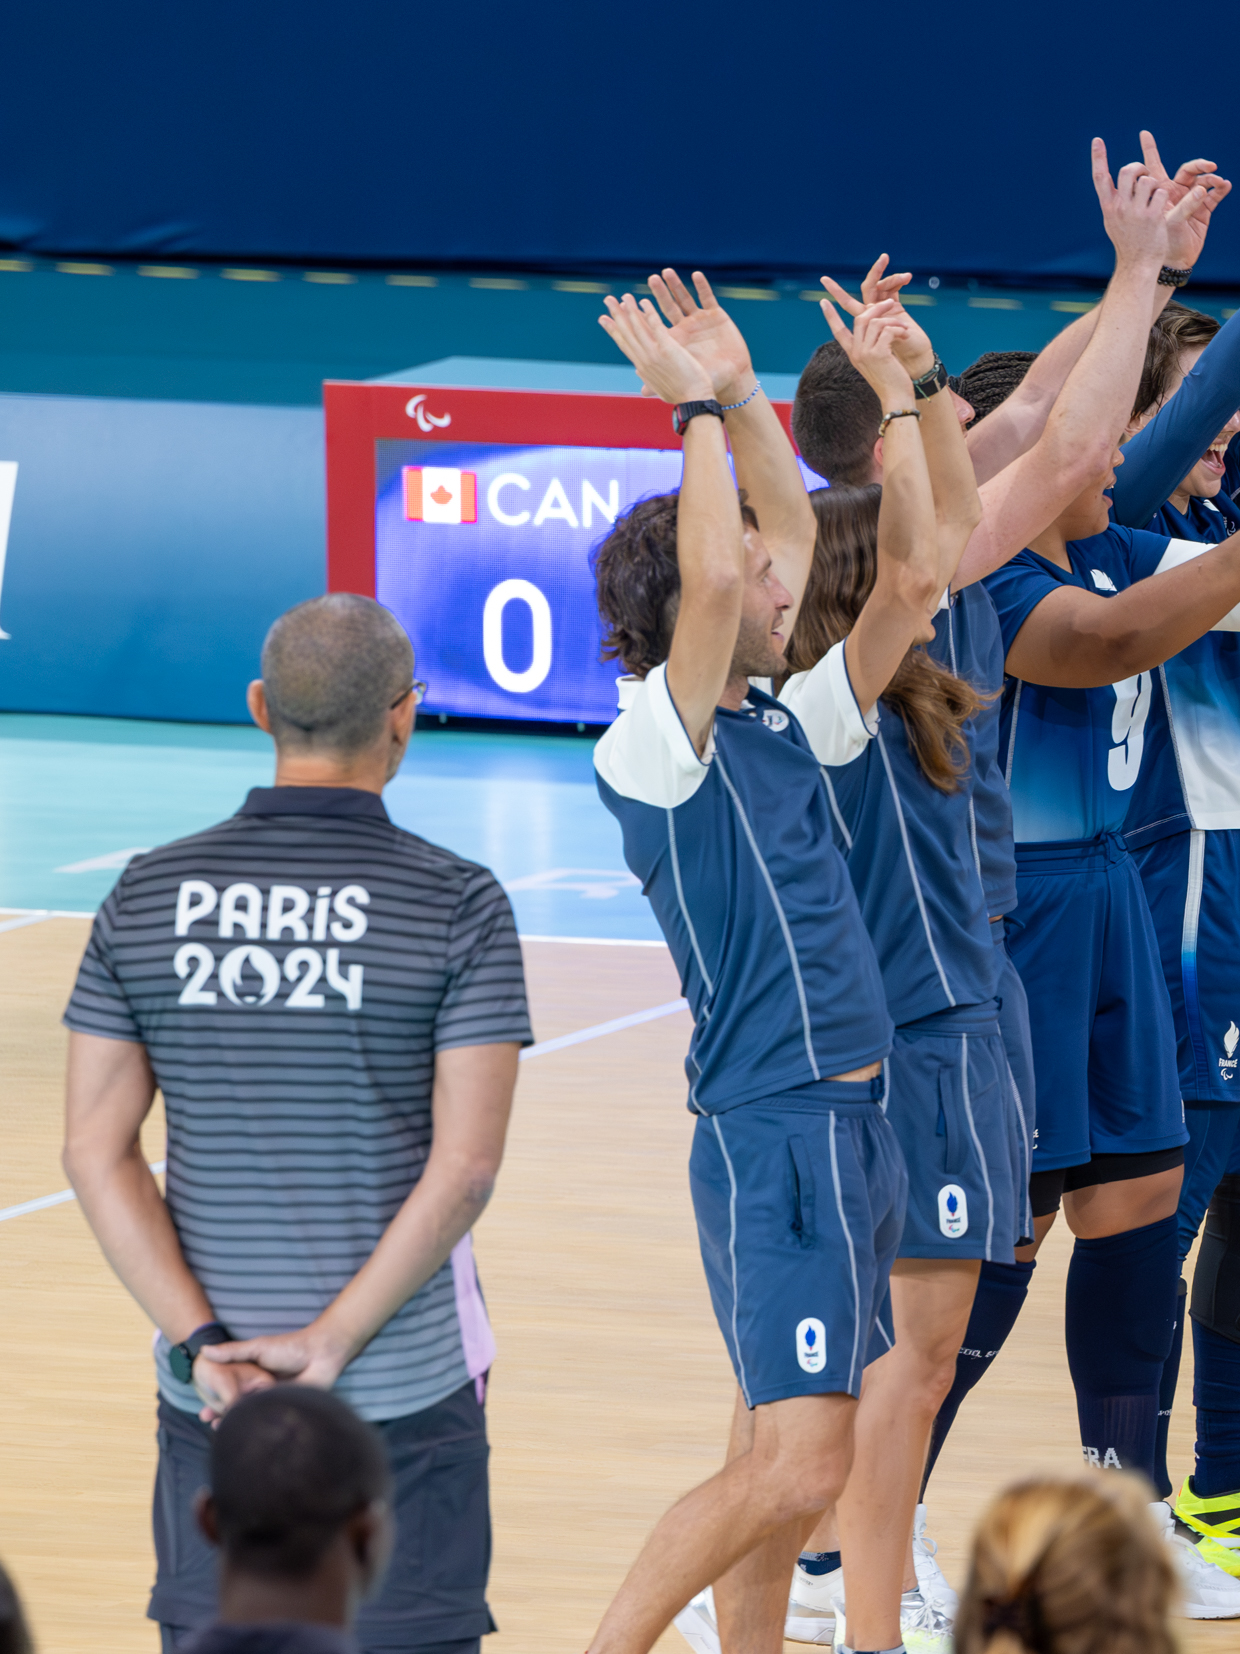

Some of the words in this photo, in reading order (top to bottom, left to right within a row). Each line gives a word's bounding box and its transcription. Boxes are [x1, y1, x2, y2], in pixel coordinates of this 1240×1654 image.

[487, 473, 620, 528] CAN
[483, 578, 552, 693] 0
[173, 942, 364, 1010] 2024
[1218, 1057, 1238, 1068] FRANCE
